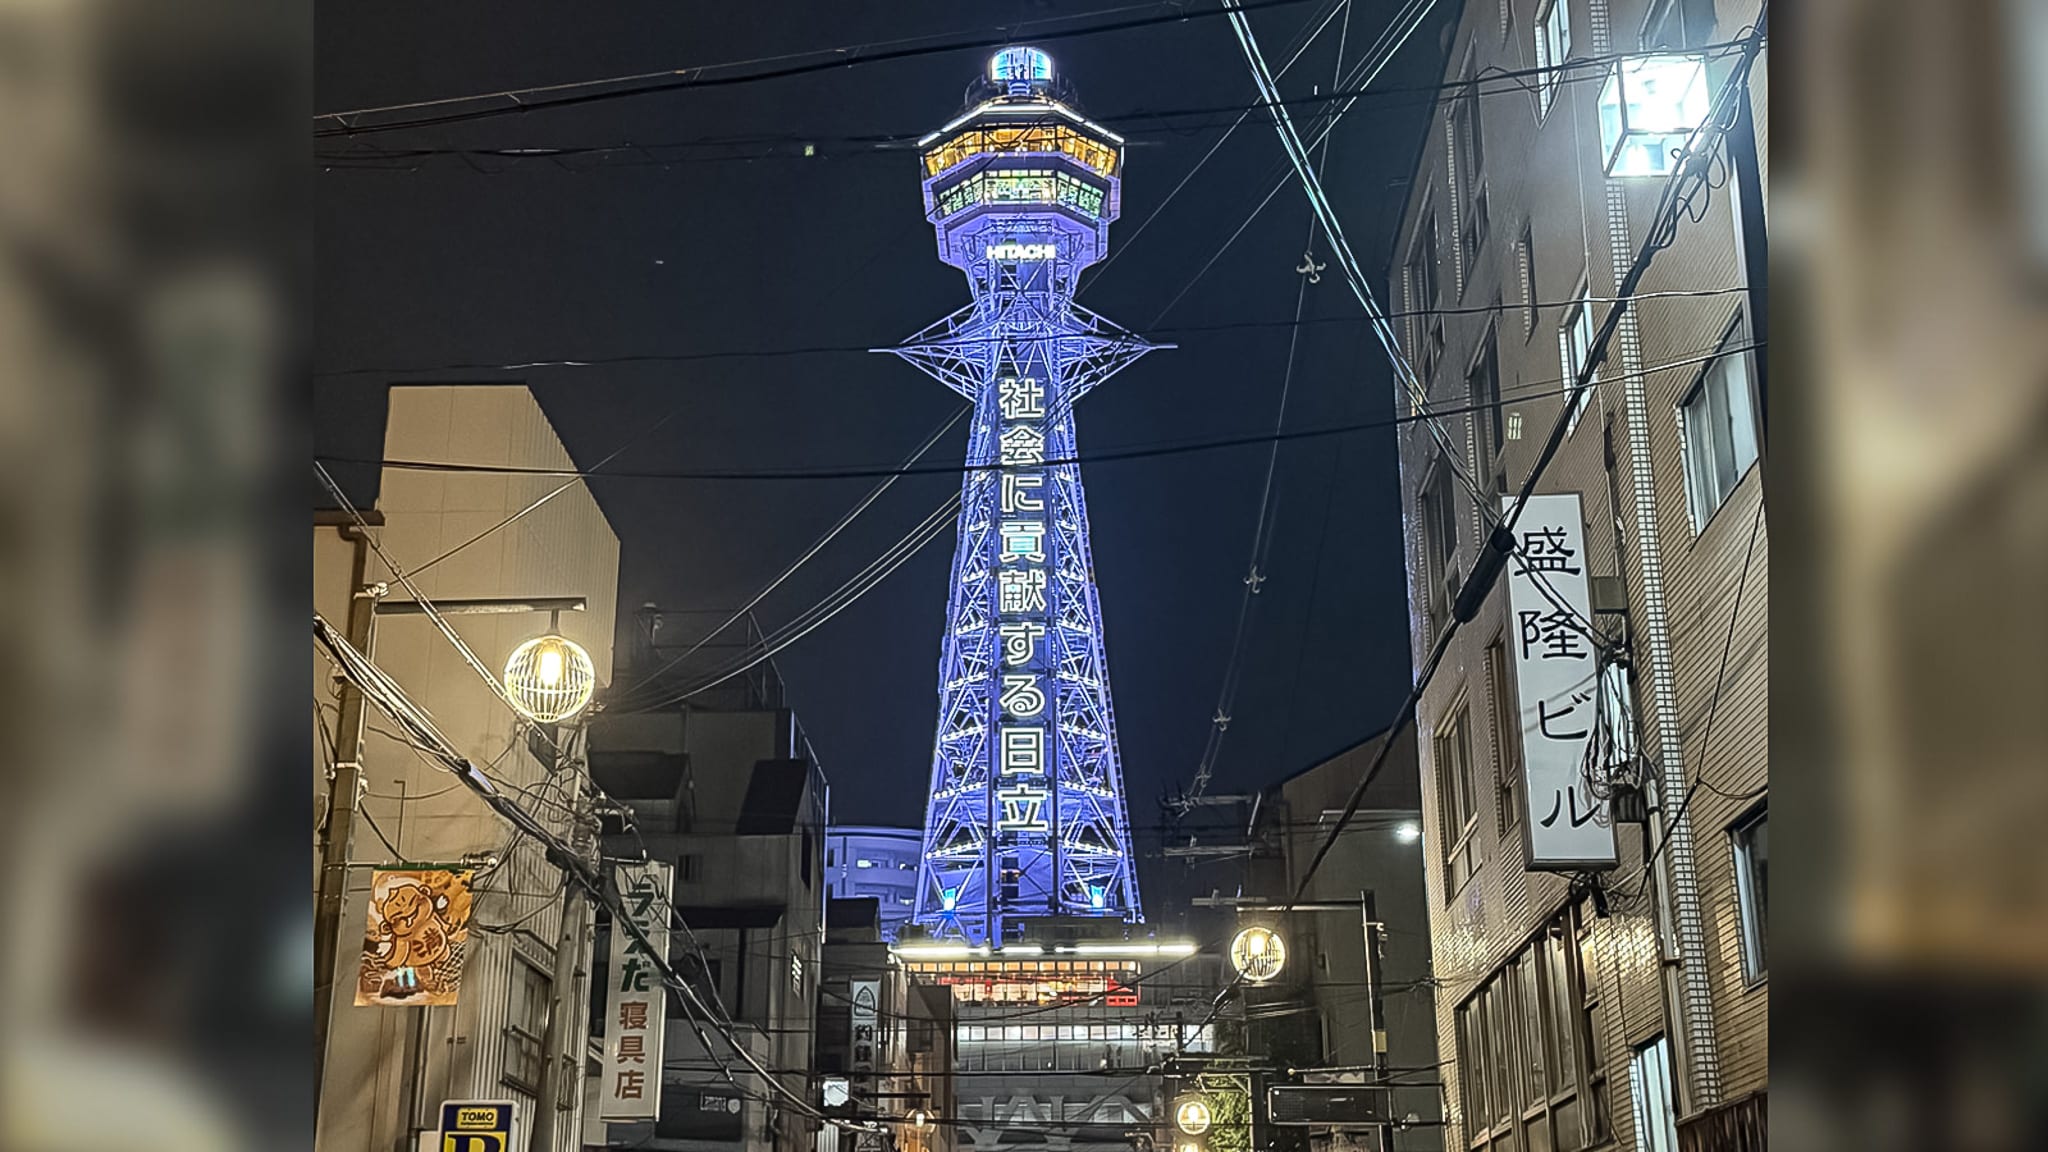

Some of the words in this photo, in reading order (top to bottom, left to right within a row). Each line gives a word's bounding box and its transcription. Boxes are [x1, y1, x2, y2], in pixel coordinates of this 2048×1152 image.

[986, 244, 1056, 260] HITACHI
[999, 377, 1047, 832] 社会に貢献する日立
[1513, 526, 1601, 829] 盛隆ビル
[461, 1111, 495, 1121] TOMO
